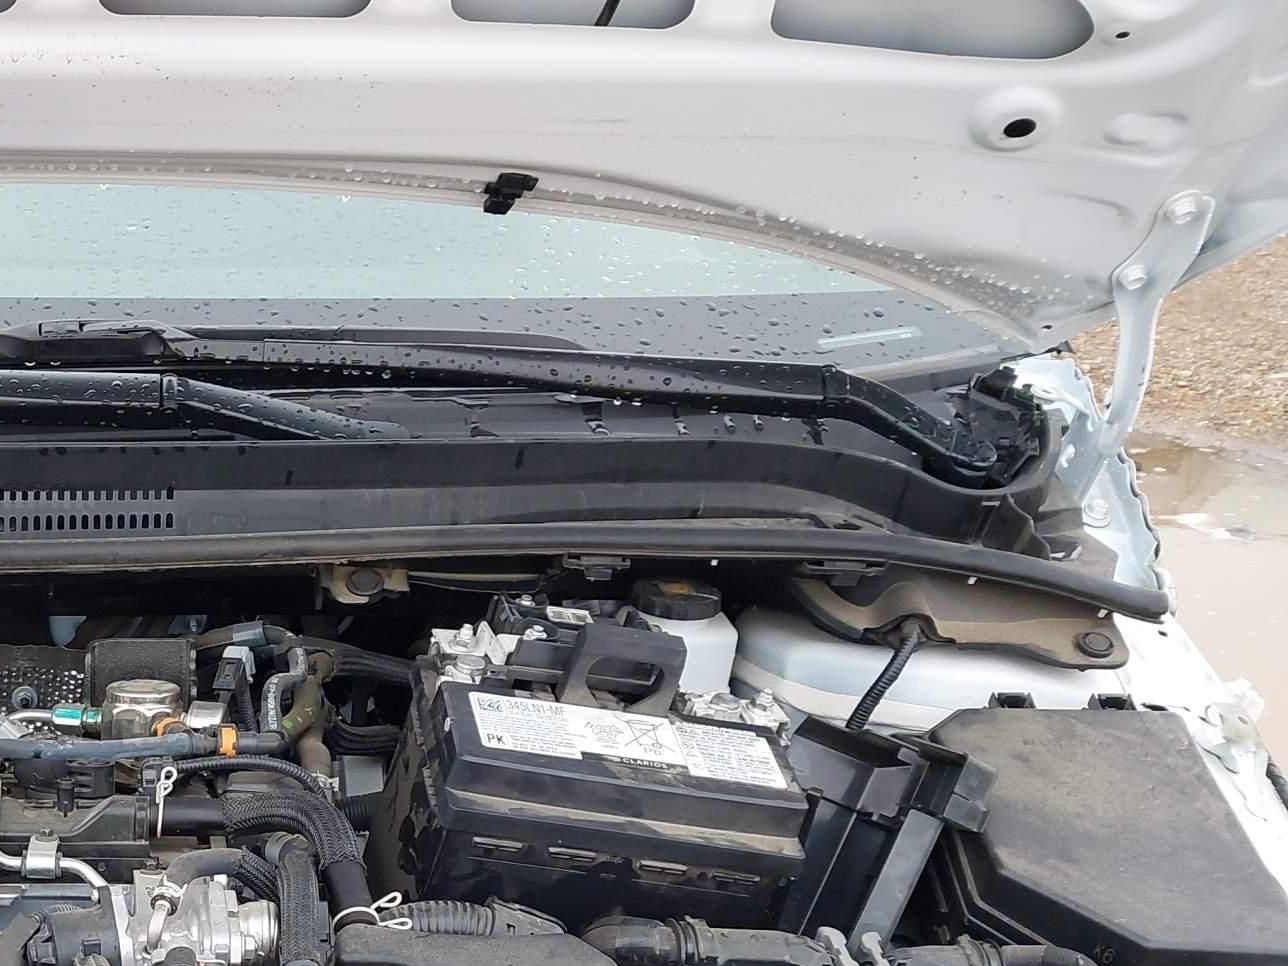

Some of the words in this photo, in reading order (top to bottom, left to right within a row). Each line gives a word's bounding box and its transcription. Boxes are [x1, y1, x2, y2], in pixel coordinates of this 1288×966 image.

[486, 733, 507, 746] PK
[621, 757, 669, 770] CLARIOS
[1095, 942, 1116, 965] K6
